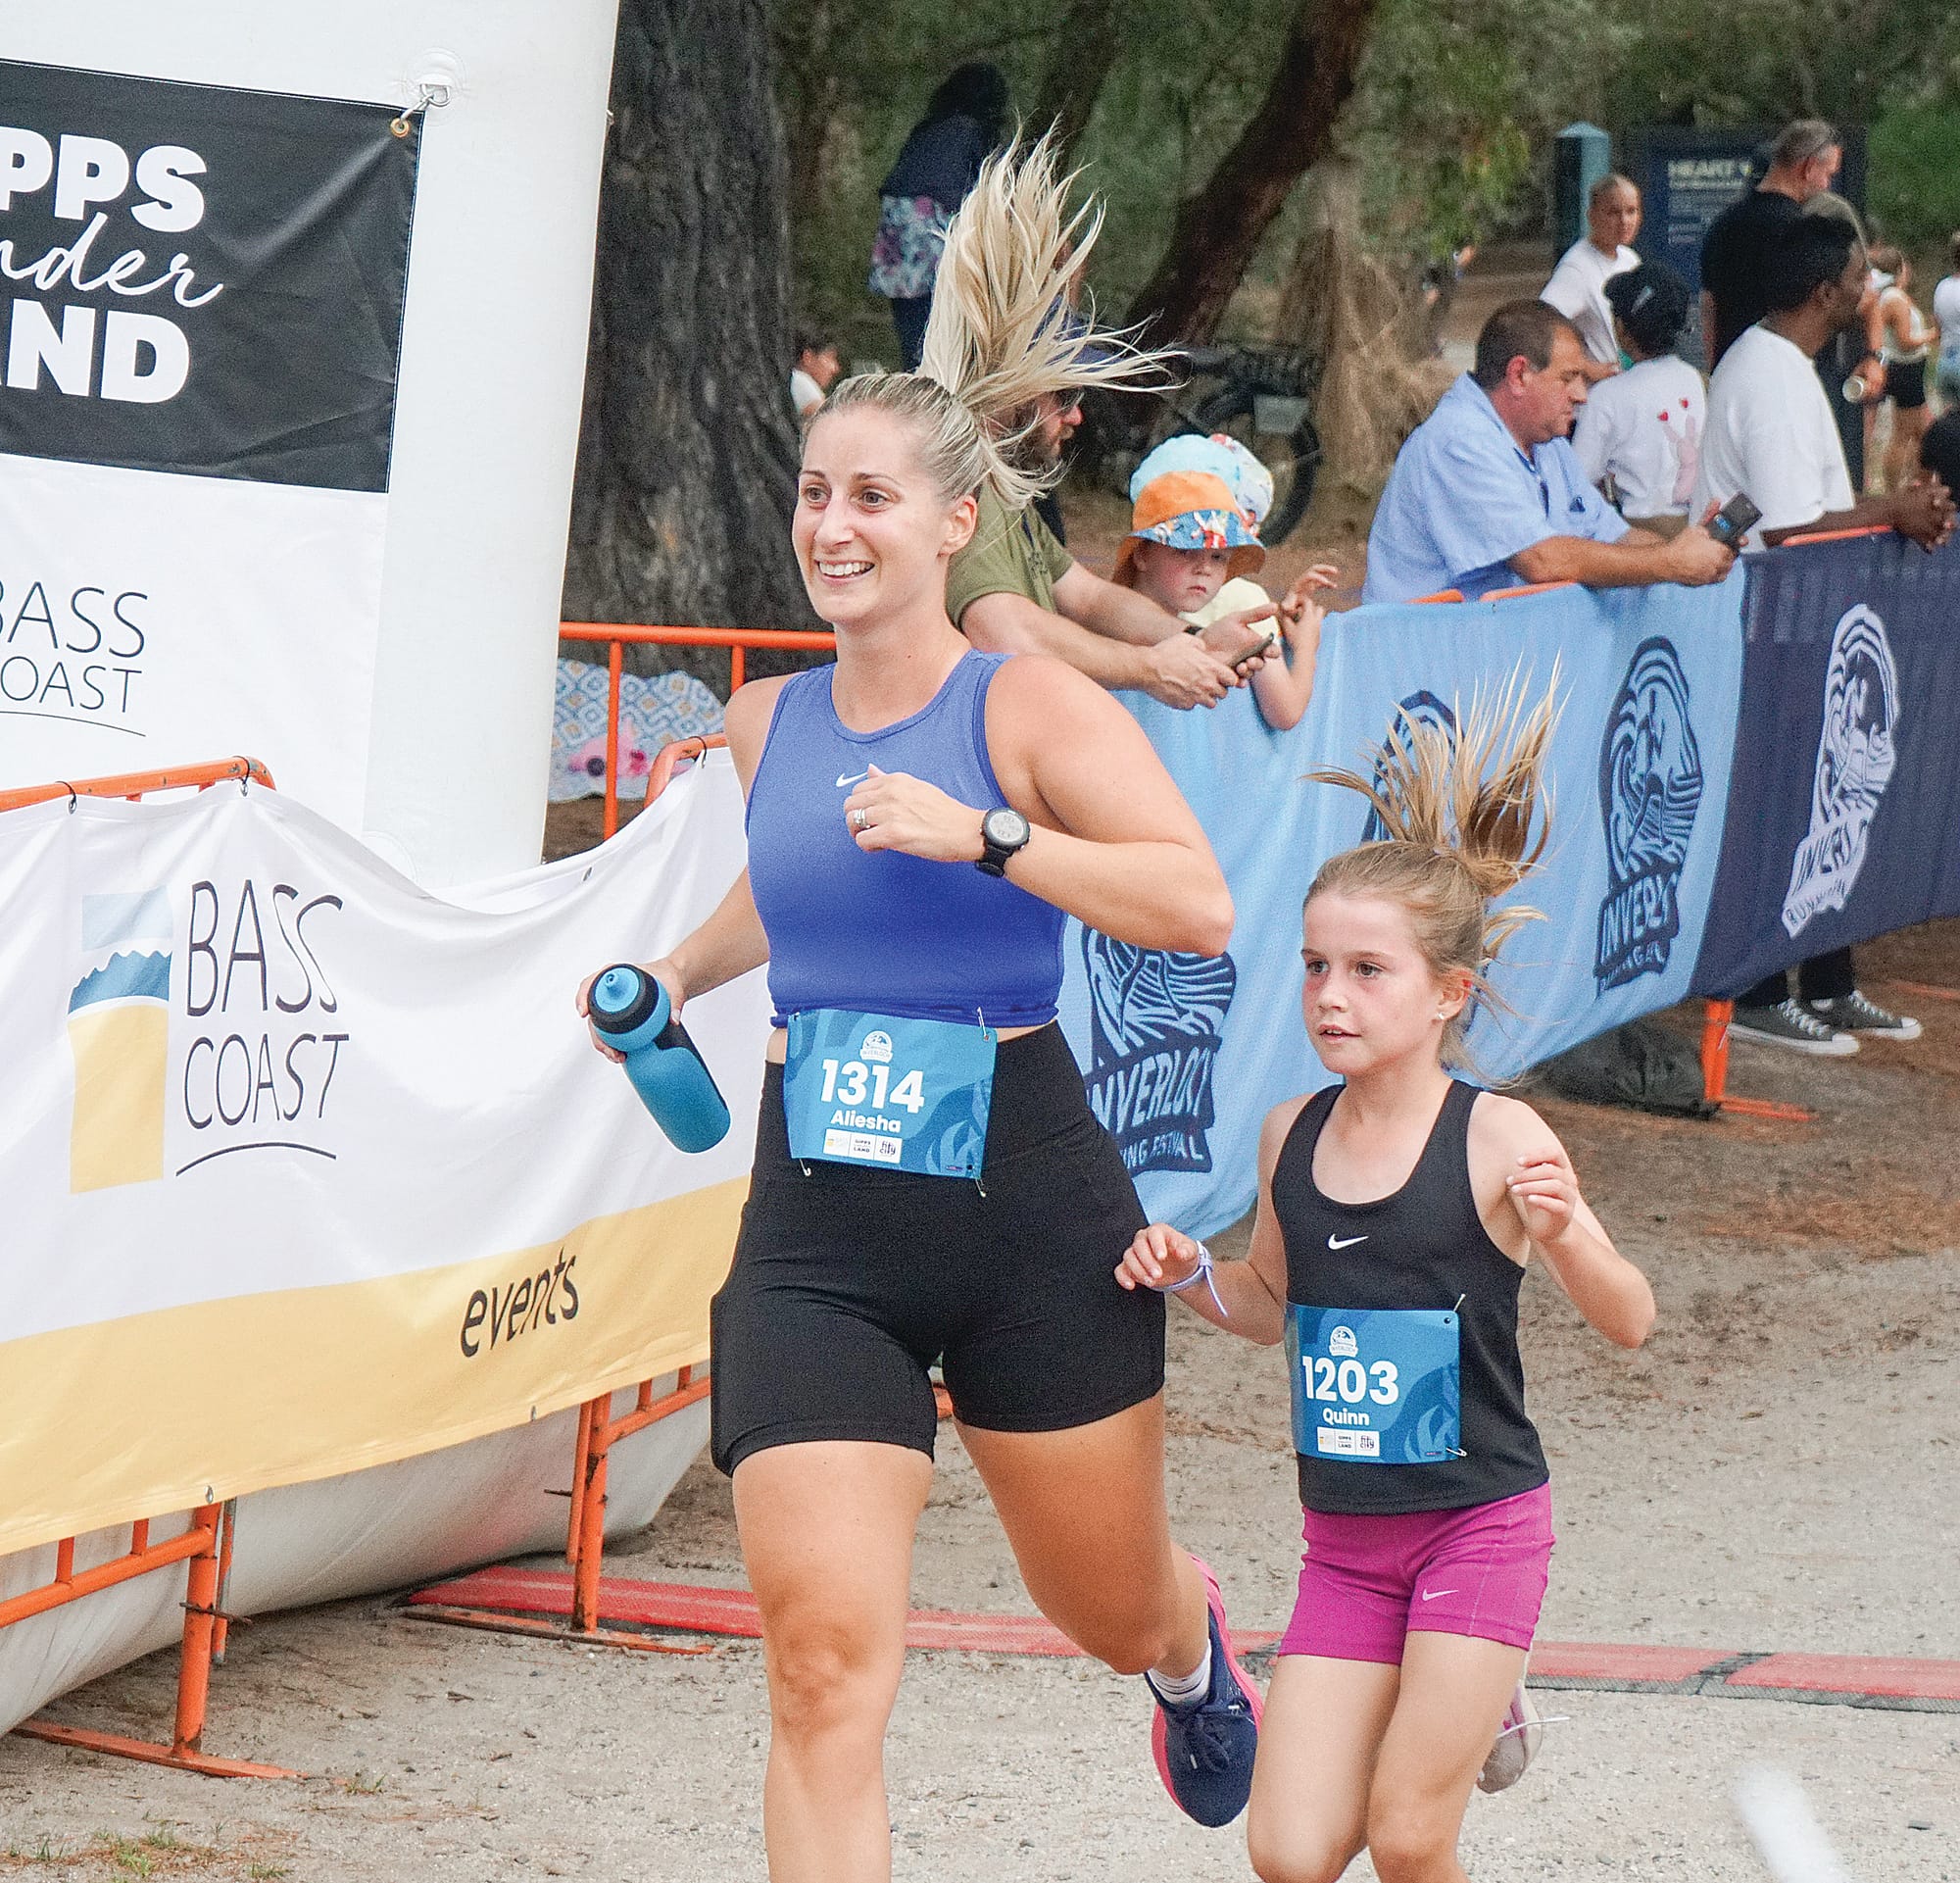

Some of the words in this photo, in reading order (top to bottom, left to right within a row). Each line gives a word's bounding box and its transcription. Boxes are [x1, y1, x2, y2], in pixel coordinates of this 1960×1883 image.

[0, 298, 190, 404] ND
[0, 580, 148, 658] ASS
[186, 879, 343, 1016] BASS
[184, 1033, 349, 1129] COAST
[821, 1059, 925, 1114] 1314
[831, 1110, 902, 1133] Aliesha
[461, 1245, 579, 1358] events
[1301, 1356, 1399, 1405] 1203
[1323, 1408, 1370, 1425] Quinn
